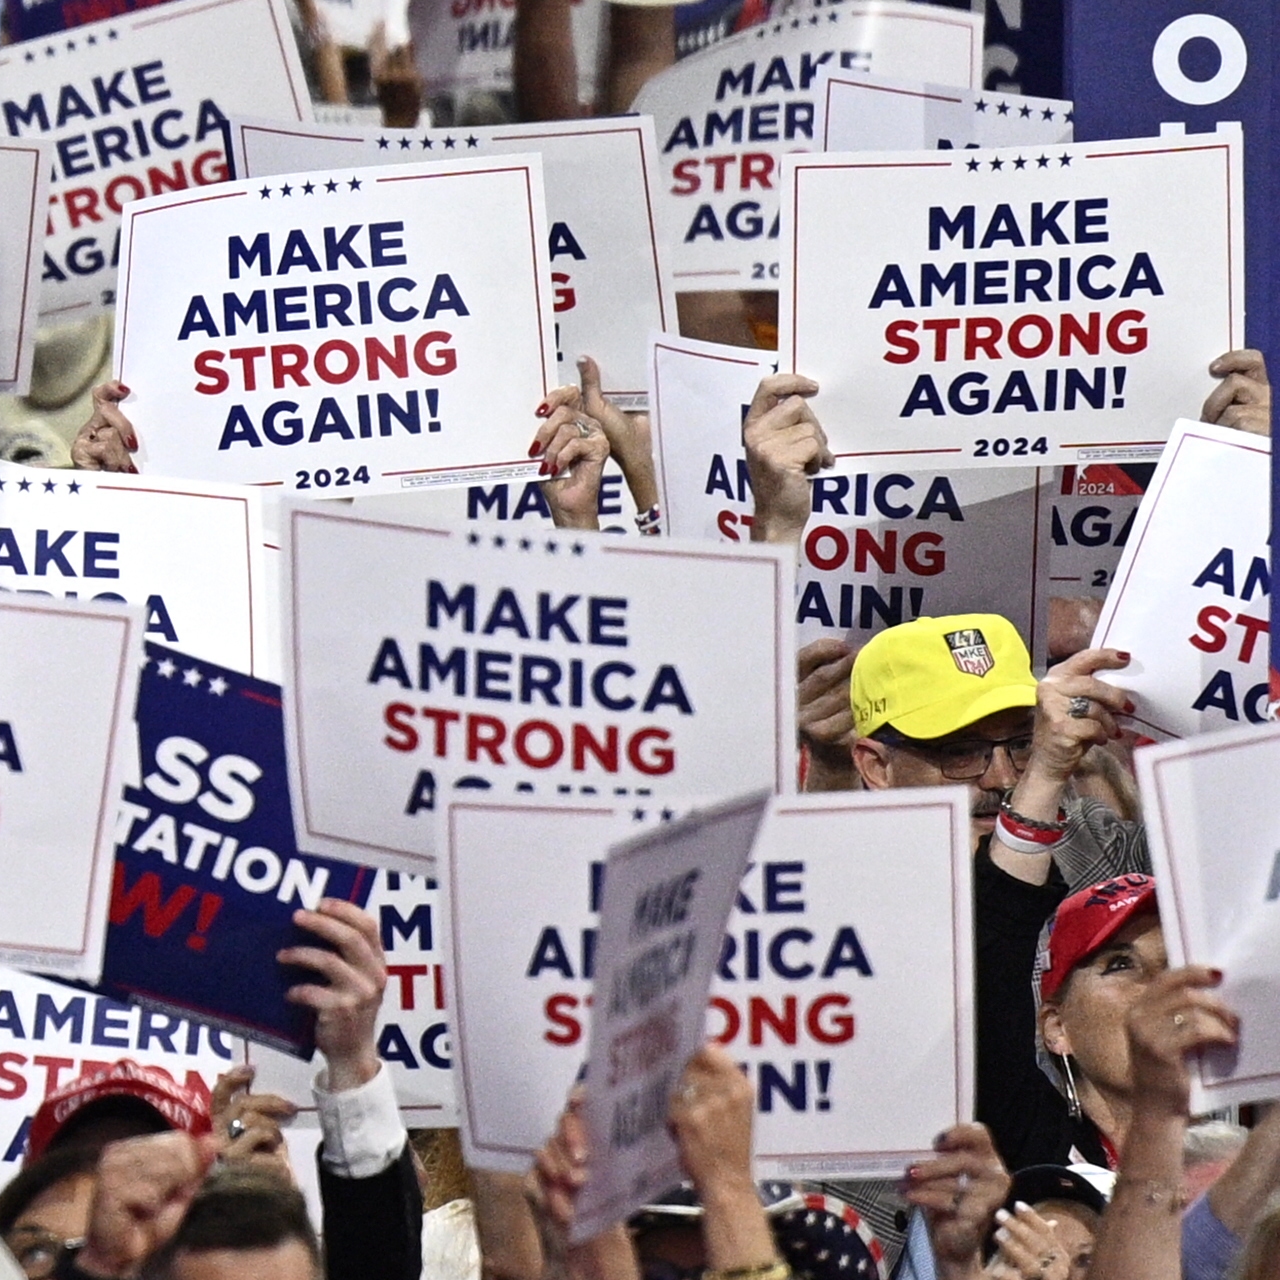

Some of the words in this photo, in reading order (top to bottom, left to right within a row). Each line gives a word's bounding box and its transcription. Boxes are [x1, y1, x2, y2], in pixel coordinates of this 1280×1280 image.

[2, 60, 172, 137] MAKE
[51, 98, 230, 183] ERICA
[662, 102, 814, 154] AMER
[228, 221, 407, 279] MAKE
[928, 198, 1109, 252] MAKE
[177, 273, 470, 342] AMERICA
[868, 251, 1164, 310] AMERICA
[194, 331, 458, 396] STRONG
[882, 309, 1149, 366] STRONG
[217, 388, 440, 451] AGAIN!
[900, 366, 1126, 418] AGAIN!
[972, 437, 1048, 458] 2024
[295, 465, 371, 490] 2024
[467, 475, 622, 521] MAE
[1078, 483, 1115, 495] 2024
[426, 579, 628, 647] MAKE
[797, 581, 924, 629] AIN!
[367, 637, 696, 716] AMERICA
[959, 647, 985, 658] MKE
[383, 701, 676, 776] STRONG
[144, 735, 262, 822] SS
